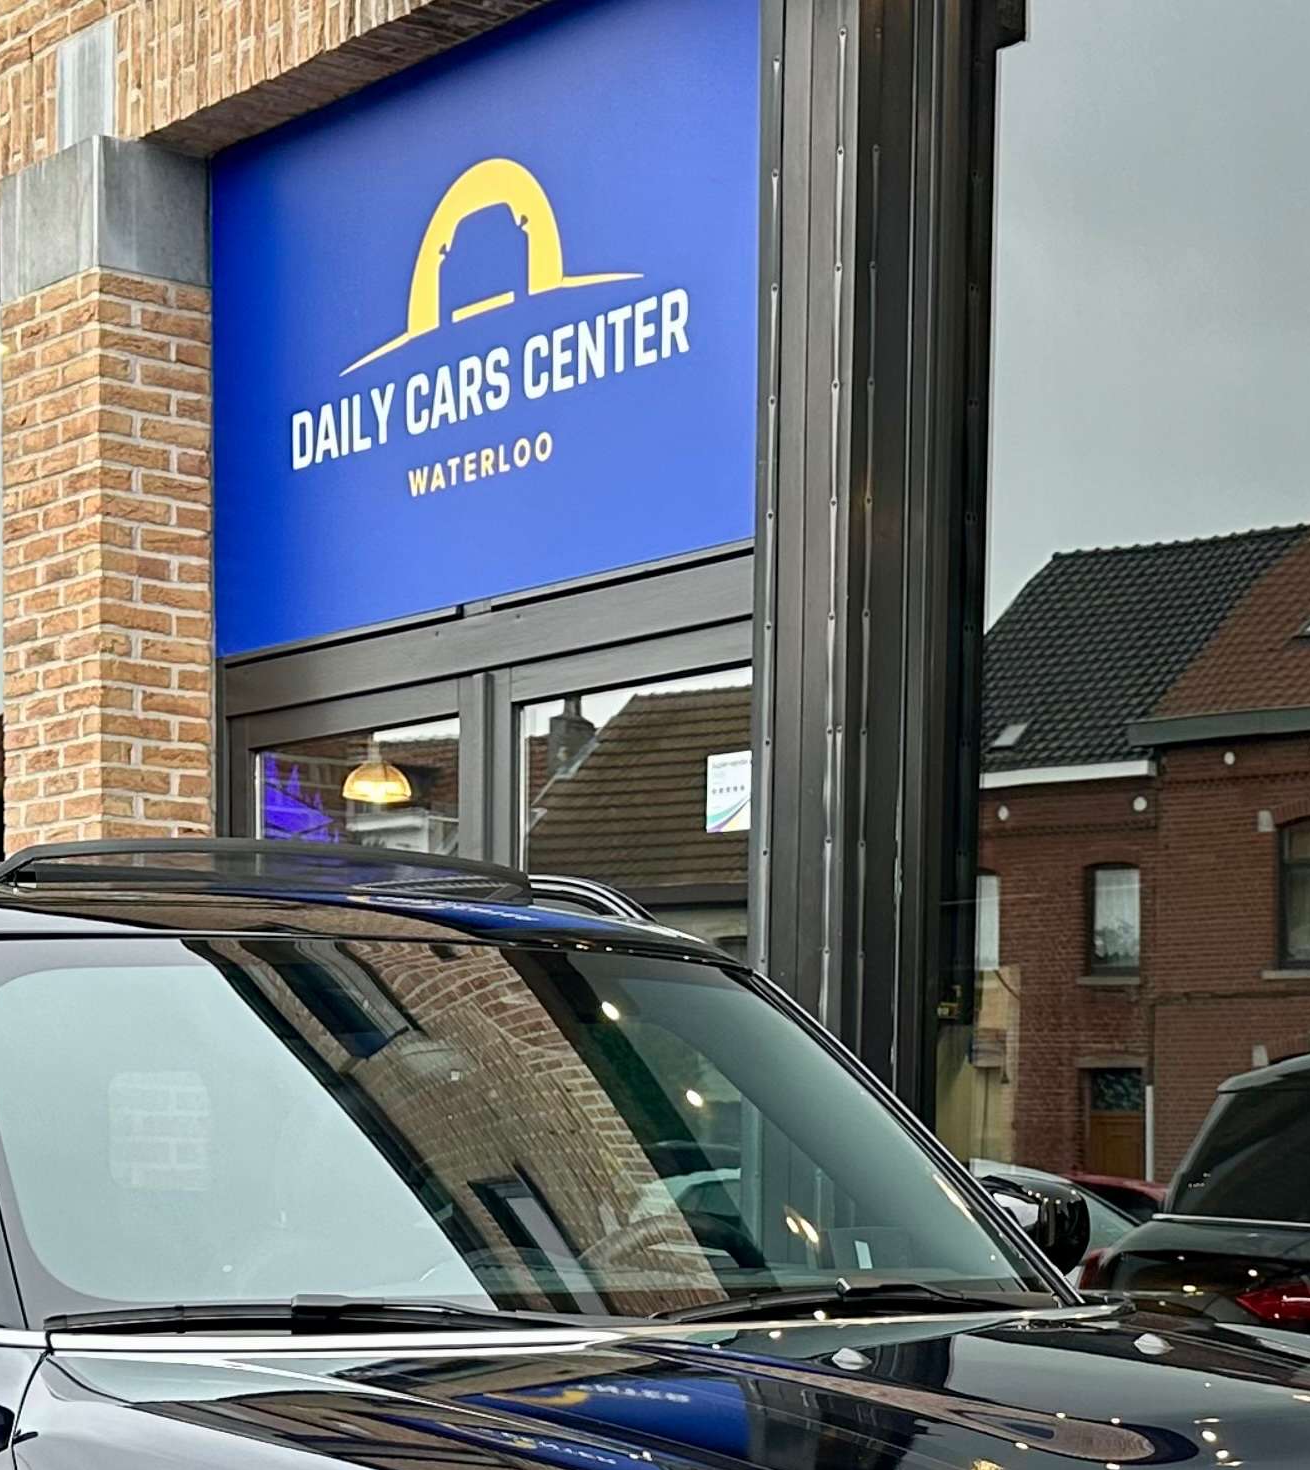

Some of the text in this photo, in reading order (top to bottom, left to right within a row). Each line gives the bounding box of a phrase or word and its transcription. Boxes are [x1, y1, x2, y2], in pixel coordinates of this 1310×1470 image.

[292, 288, 690, 470] DAILY CARS CENTER
[407, 431, 554, 497] WATERLOO
